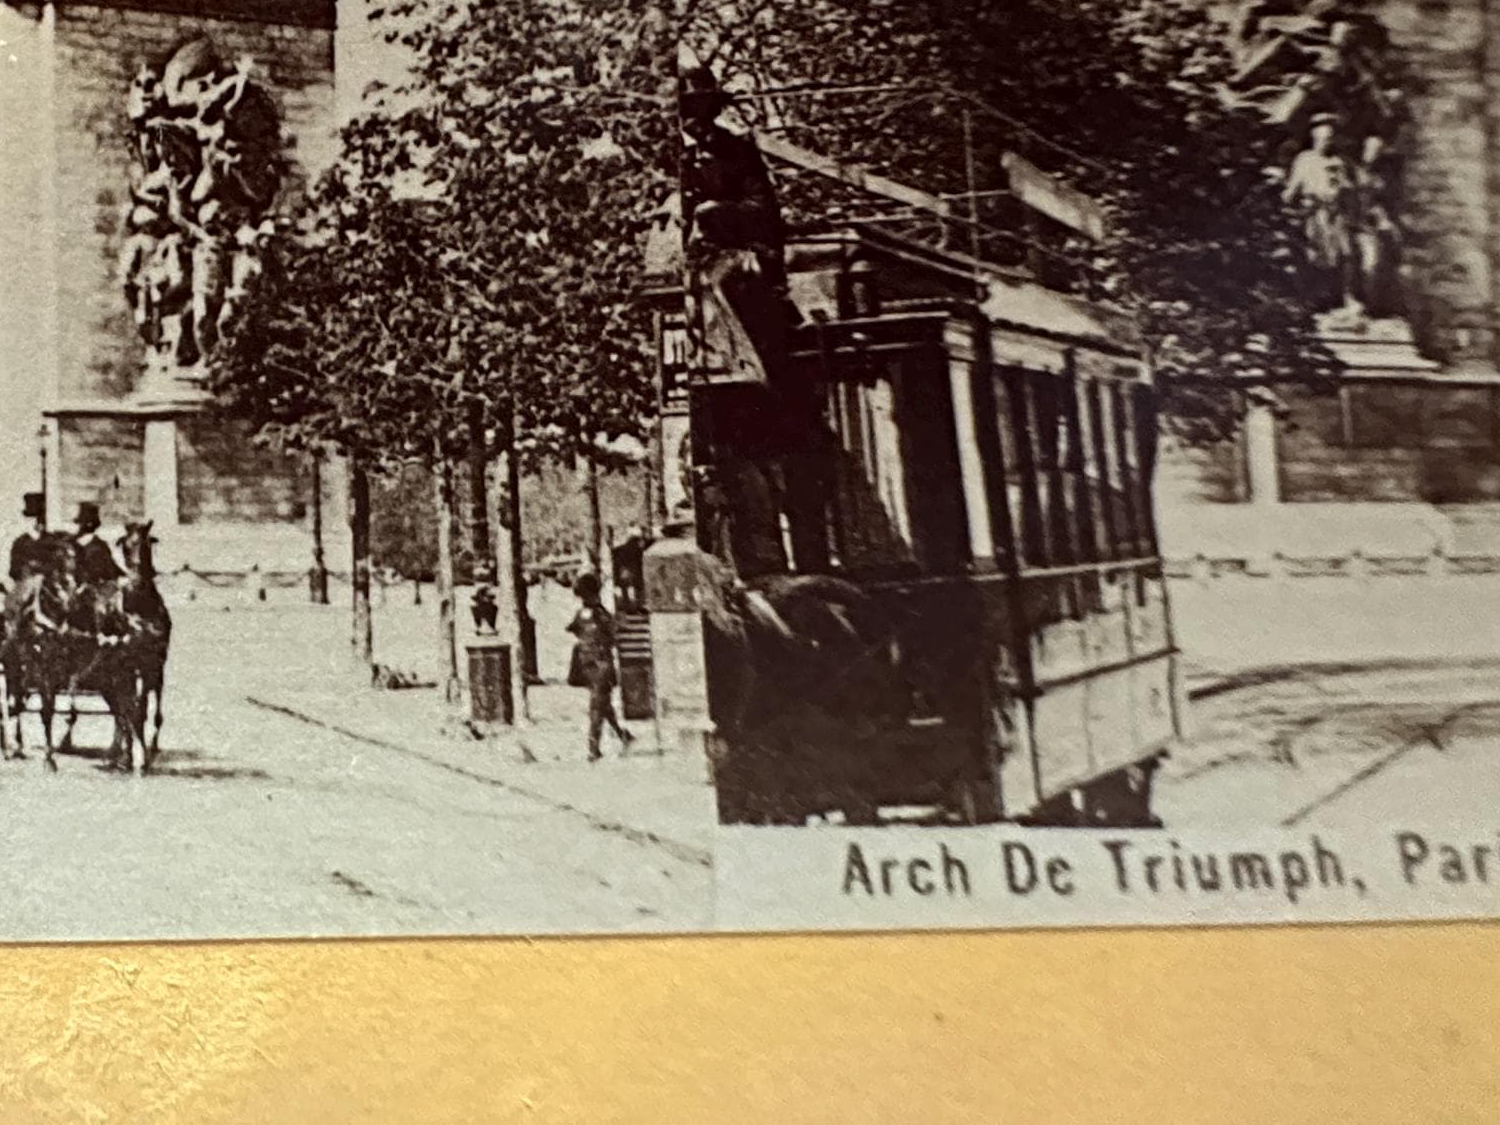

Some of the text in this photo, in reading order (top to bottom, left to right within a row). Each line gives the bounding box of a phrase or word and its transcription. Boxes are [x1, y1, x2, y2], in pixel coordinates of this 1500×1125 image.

[841, 831, 1500, 903] Arch De Triumph, Par
